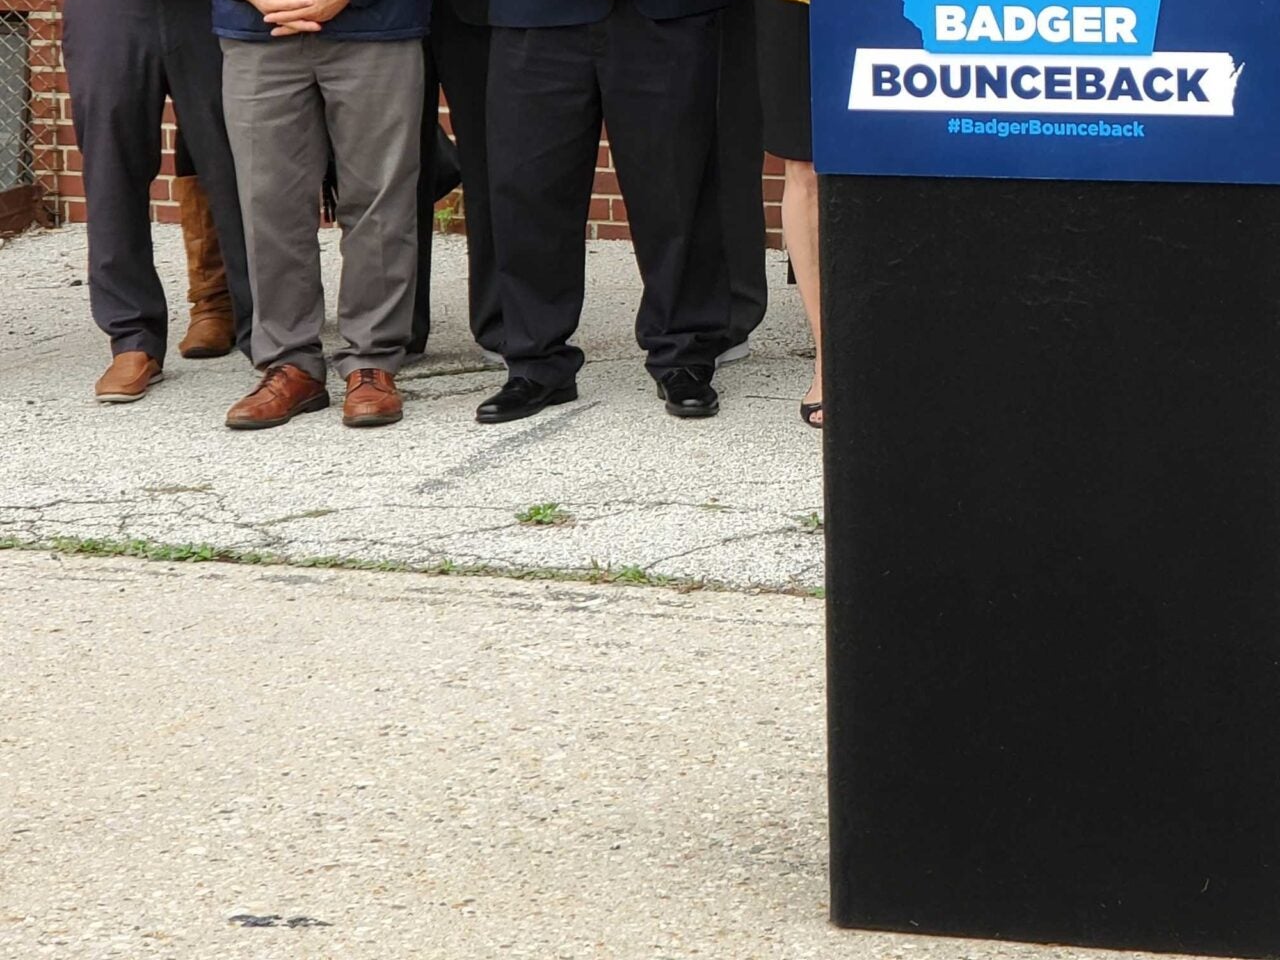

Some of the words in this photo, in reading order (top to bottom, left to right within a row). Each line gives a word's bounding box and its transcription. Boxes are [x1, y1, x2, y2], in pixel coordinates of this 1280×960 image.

[934, 5, 1138, 44] BADGER
[871, 63, 1210, 103] BOUNCEBACK
[947, 118, 1145, 139] #BadgerBounceback
